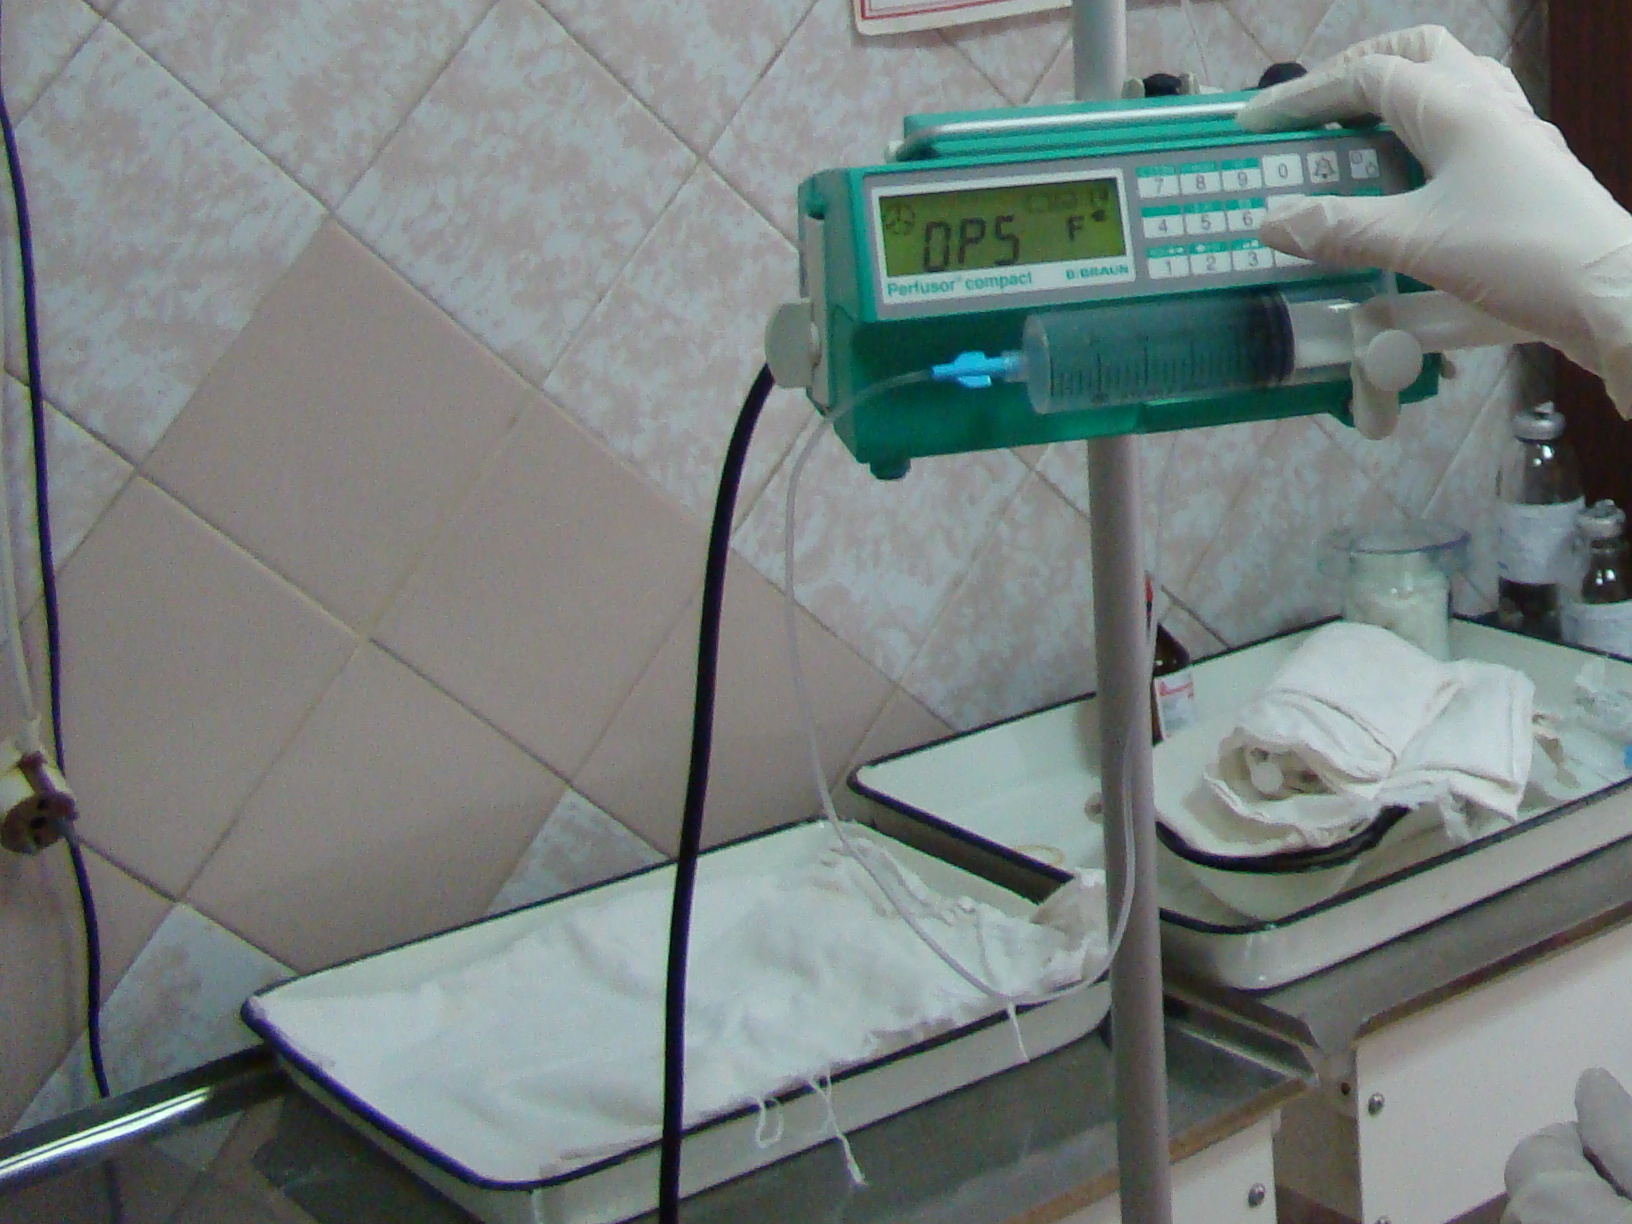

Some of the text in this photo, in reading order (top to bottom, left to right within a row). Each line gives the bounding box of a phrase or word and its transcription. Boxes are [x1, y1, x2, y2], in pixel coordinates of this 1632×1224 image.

[1154, 178, 1164, 193] 7
[1196, 176, 1205, 190] 8
[1278, 163, 1288, 178] 0
[1158, 212, 1253, 232] 4 5 6
[1248, 251, 1258, 266] 3
[965, 270, 1032, 293] compact
